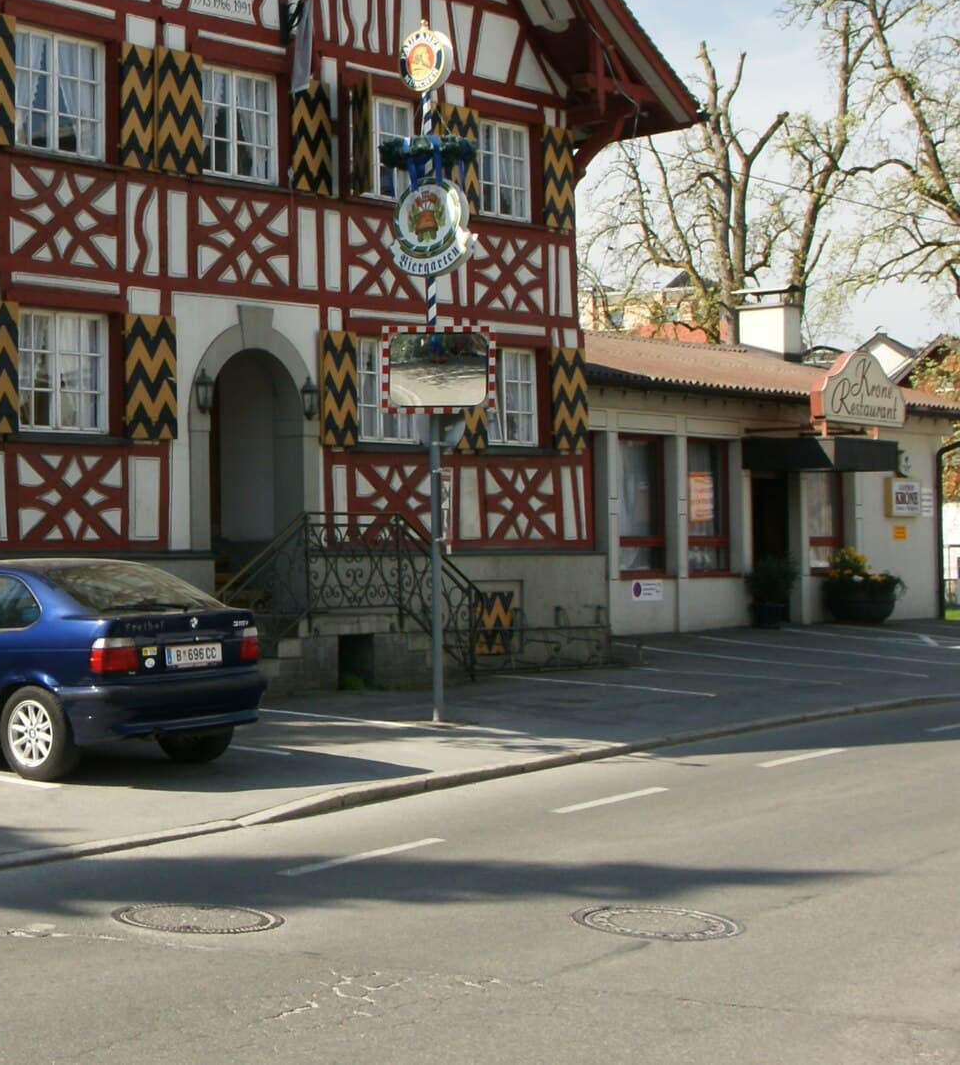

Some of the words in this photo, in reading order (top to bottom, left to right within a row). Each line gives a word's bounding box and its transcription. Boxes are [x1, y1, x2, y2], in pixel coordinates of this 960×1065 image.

[399, 246, 460, 275] Biergarten
[851, 358, 892, 399] Krone
[831, 378, 897, 420] Restaurant
[895, 491, 919, 506] KRONE
